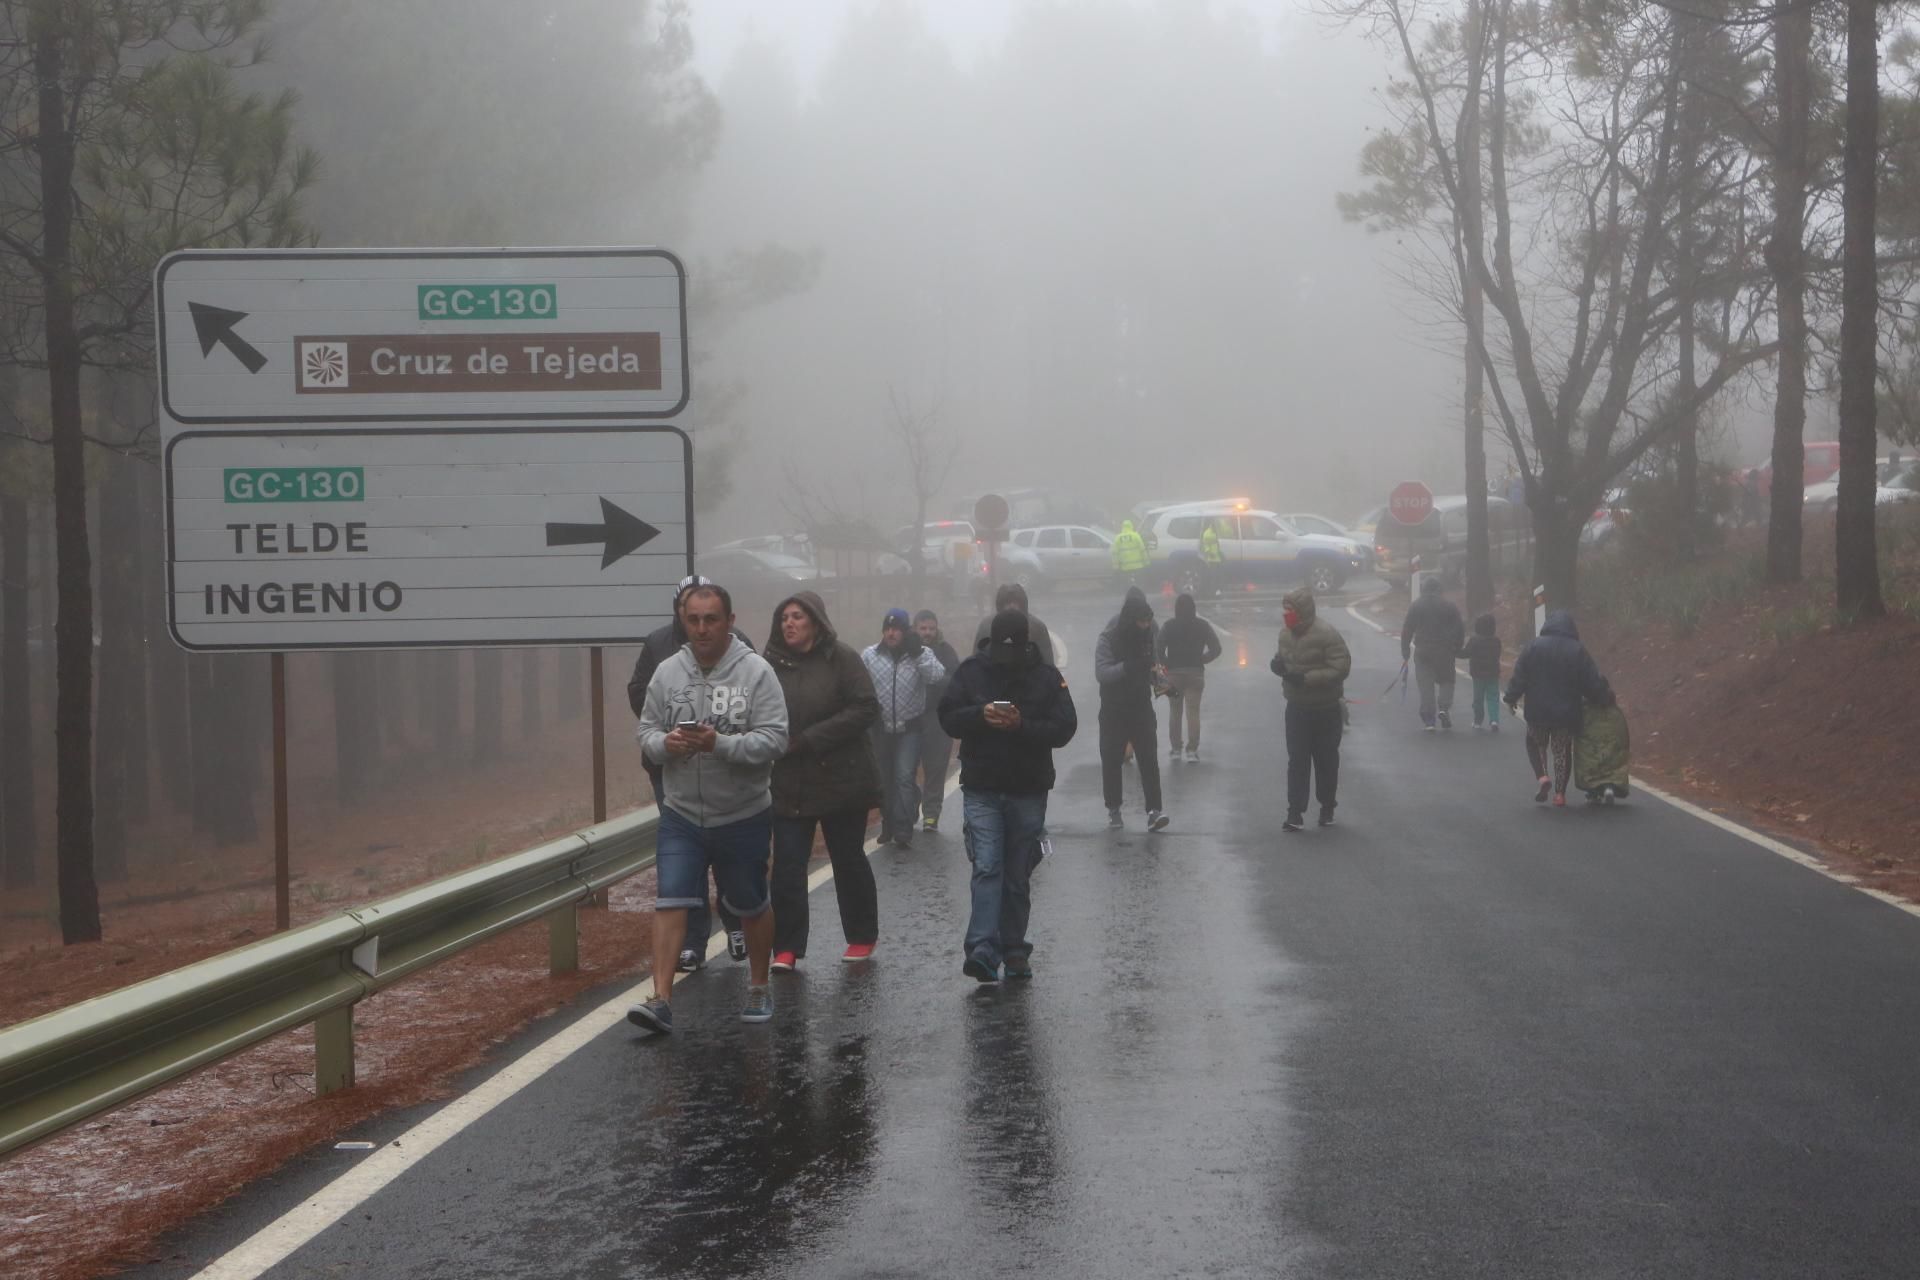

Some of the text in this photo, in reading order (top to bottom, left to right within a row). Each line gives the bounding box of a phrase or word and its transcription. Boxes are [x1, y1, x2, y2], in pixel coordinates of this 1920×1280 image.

[423, 289, 552, 315] GC-130
[370, 346, 640, 379] Cruz de Tejeda
[229, 472, 359, 498] GC-130
[1392, 496, 1428, 509] STOP
[226, 522, 368, 553] TELDE
[205, 581, 402, 615] INGENIO
